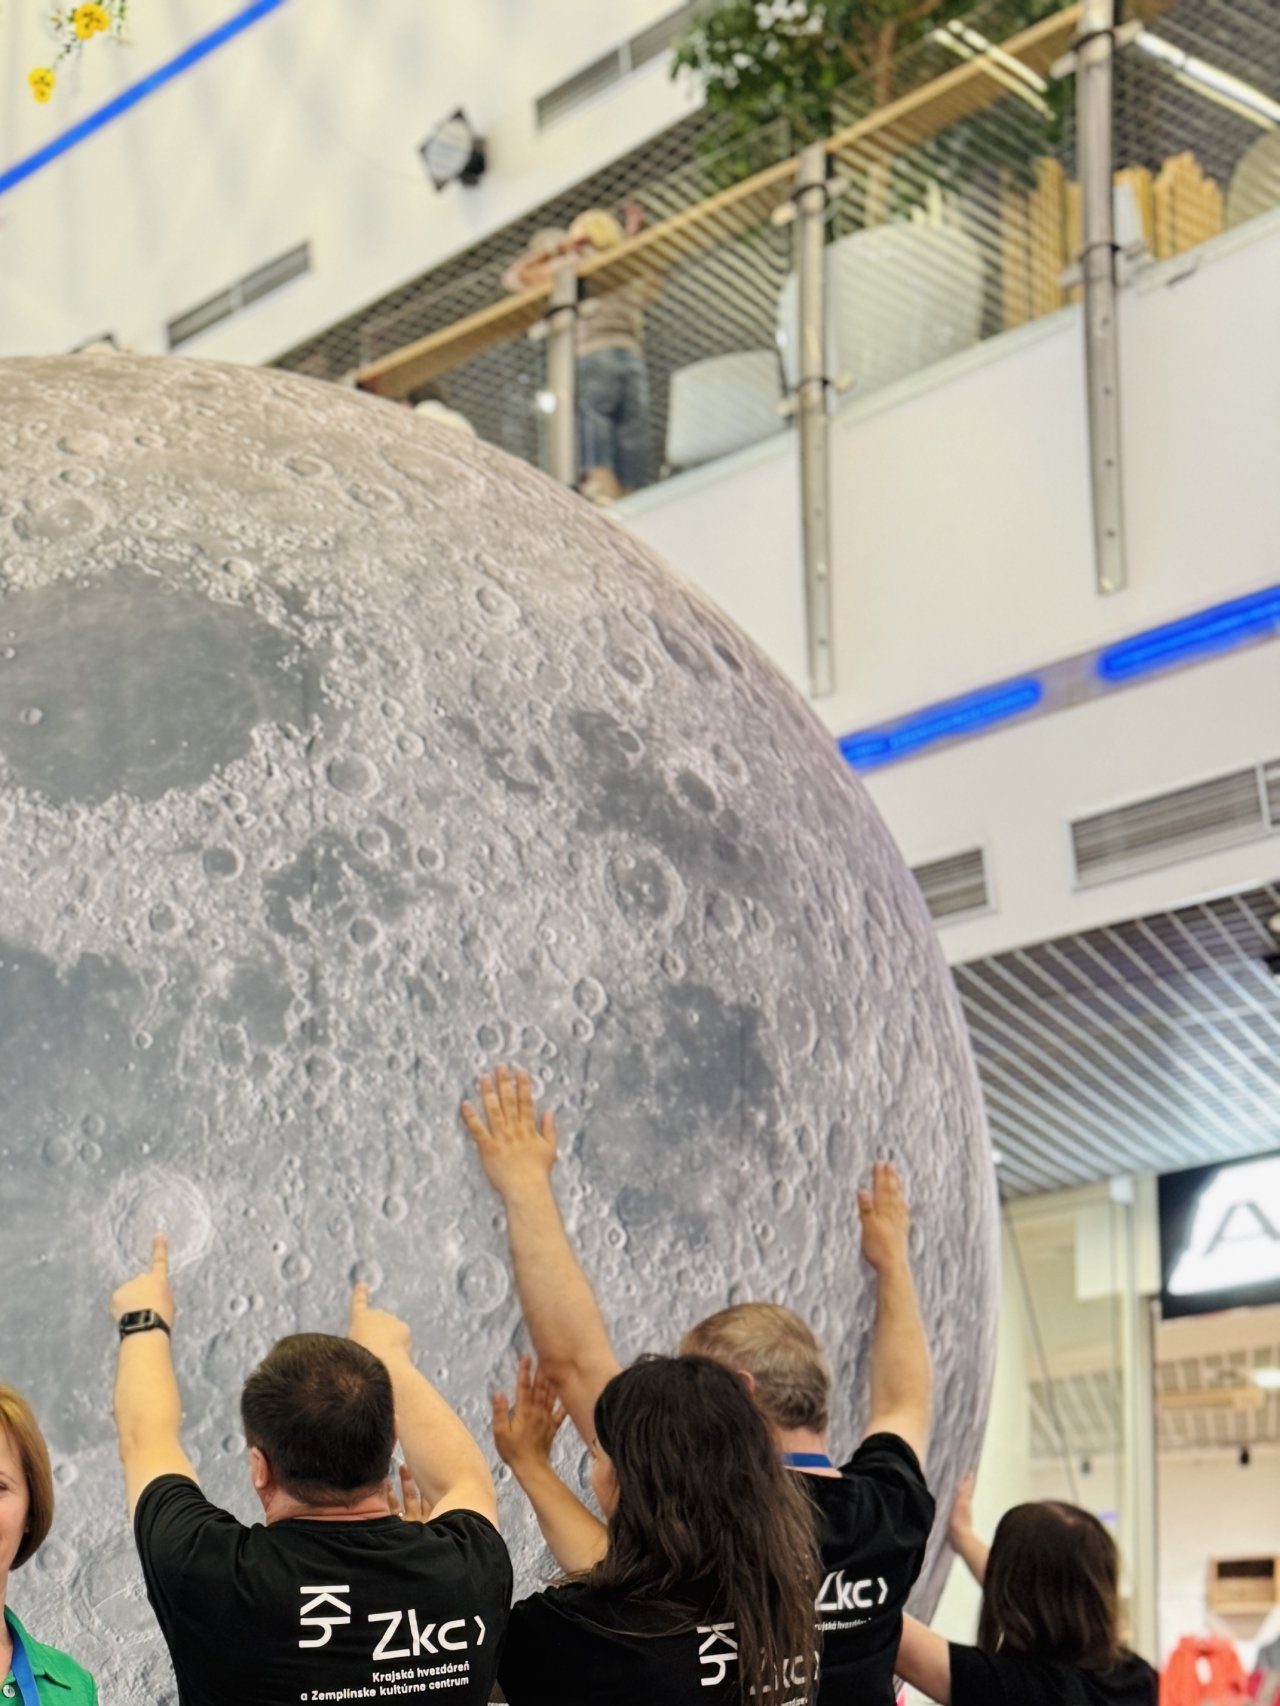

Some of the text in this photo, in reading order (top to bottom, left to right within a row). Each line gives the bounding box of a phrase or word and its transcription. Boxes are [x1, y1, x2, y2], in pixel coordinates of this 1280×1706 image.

[367, 1608, 469, 1661] Zkc
[372, 1660, 470, 1684] Krajská hvezdáreň
[300, 1676, 470, 1702] a Zemplínske kultúrne centrum
